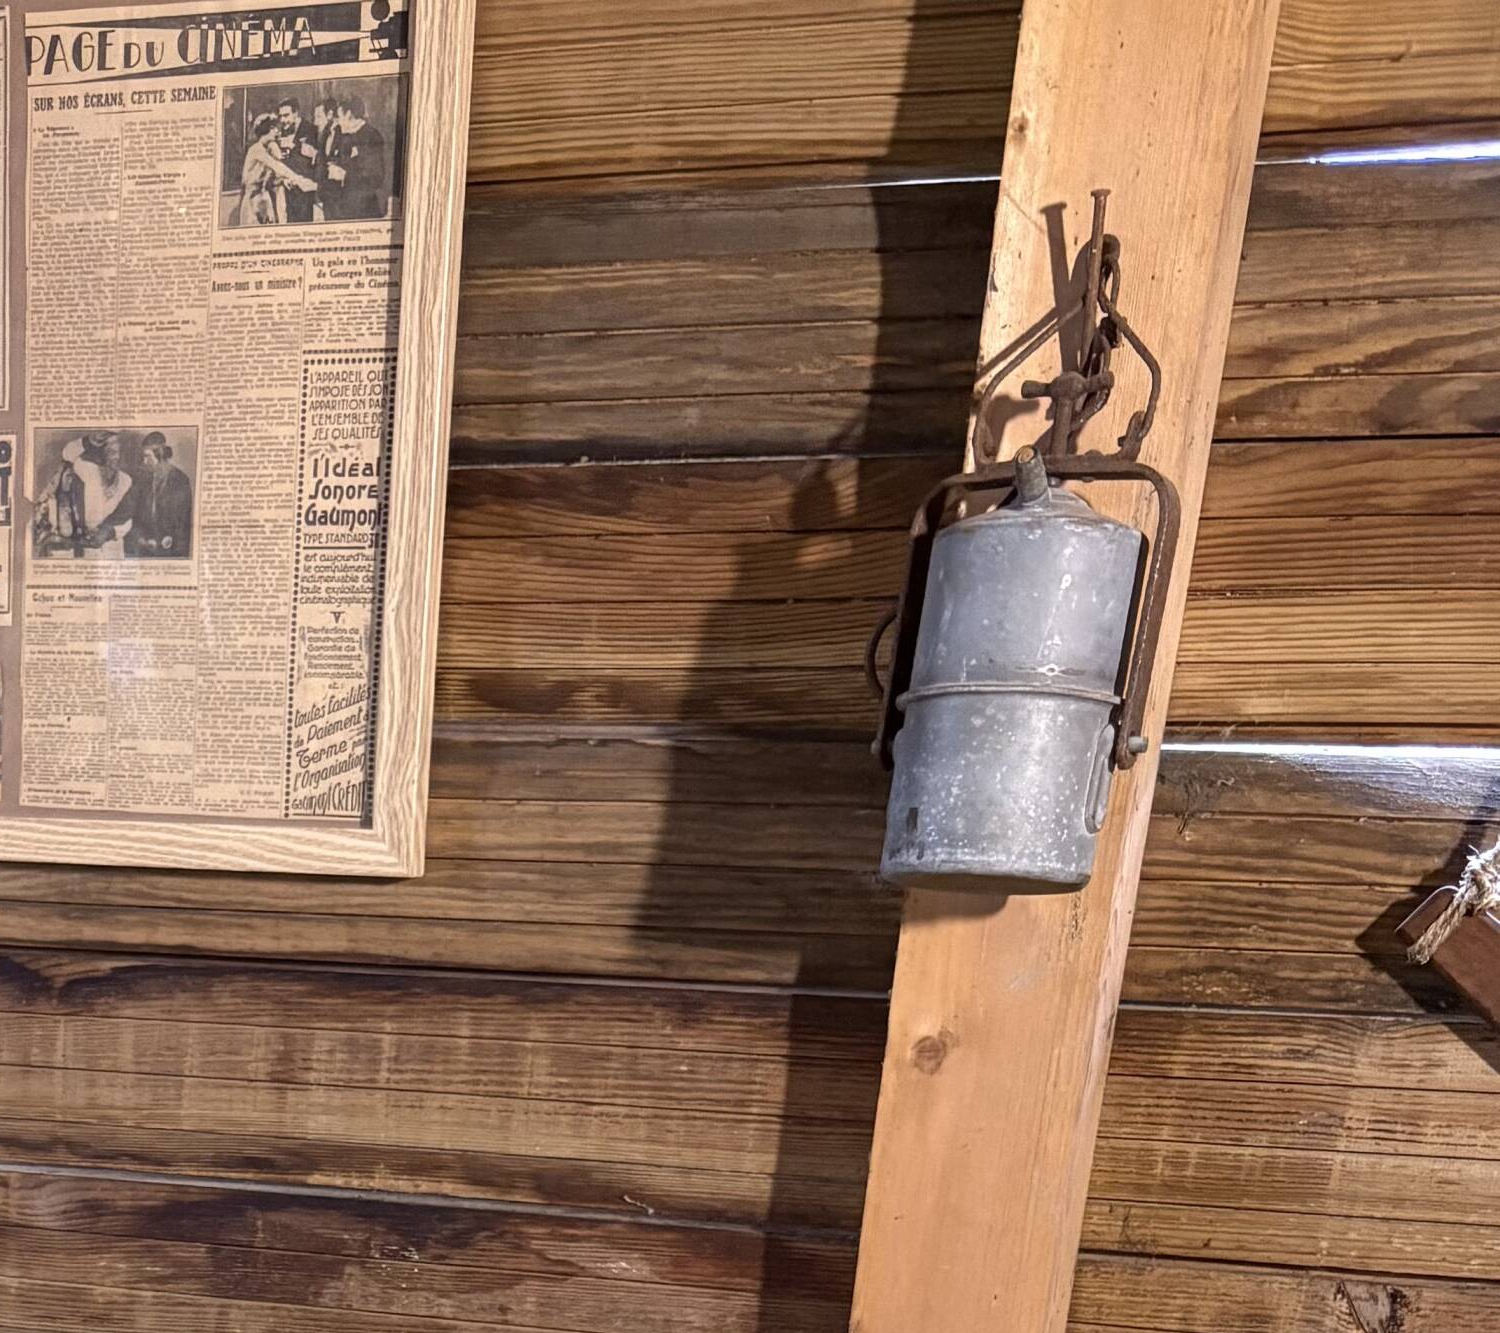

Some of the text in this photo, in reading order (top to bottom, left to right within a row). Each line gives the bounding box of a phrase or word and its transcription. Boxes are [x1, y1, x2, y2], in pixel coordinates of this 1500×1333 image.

[25, 30, 116, 76] PAGE
[124, 41, 164, 69] DU
[34, 85, 216, 112] SUR NOS ÉCRANS, CETTE SEMAINE
[309, 370, 364, 385] L'APPAREIL
[309, 399, 366, 412] APPARITION
[311, 412, 369, 426] L'ENSEMBLE
[312, 427, 328, 441] SES
[309, 479, 379, 504] Sonore
[304, 503, 382, 531] Gaumont
[303, 533, 323, 544] TYPE
[325, 533, 368, 544] STANDARD
[294, 683, 371, 728] toutes facilités
[307, 706, 363, 743] Paiement
[296, 740, 347, 769] Terme
